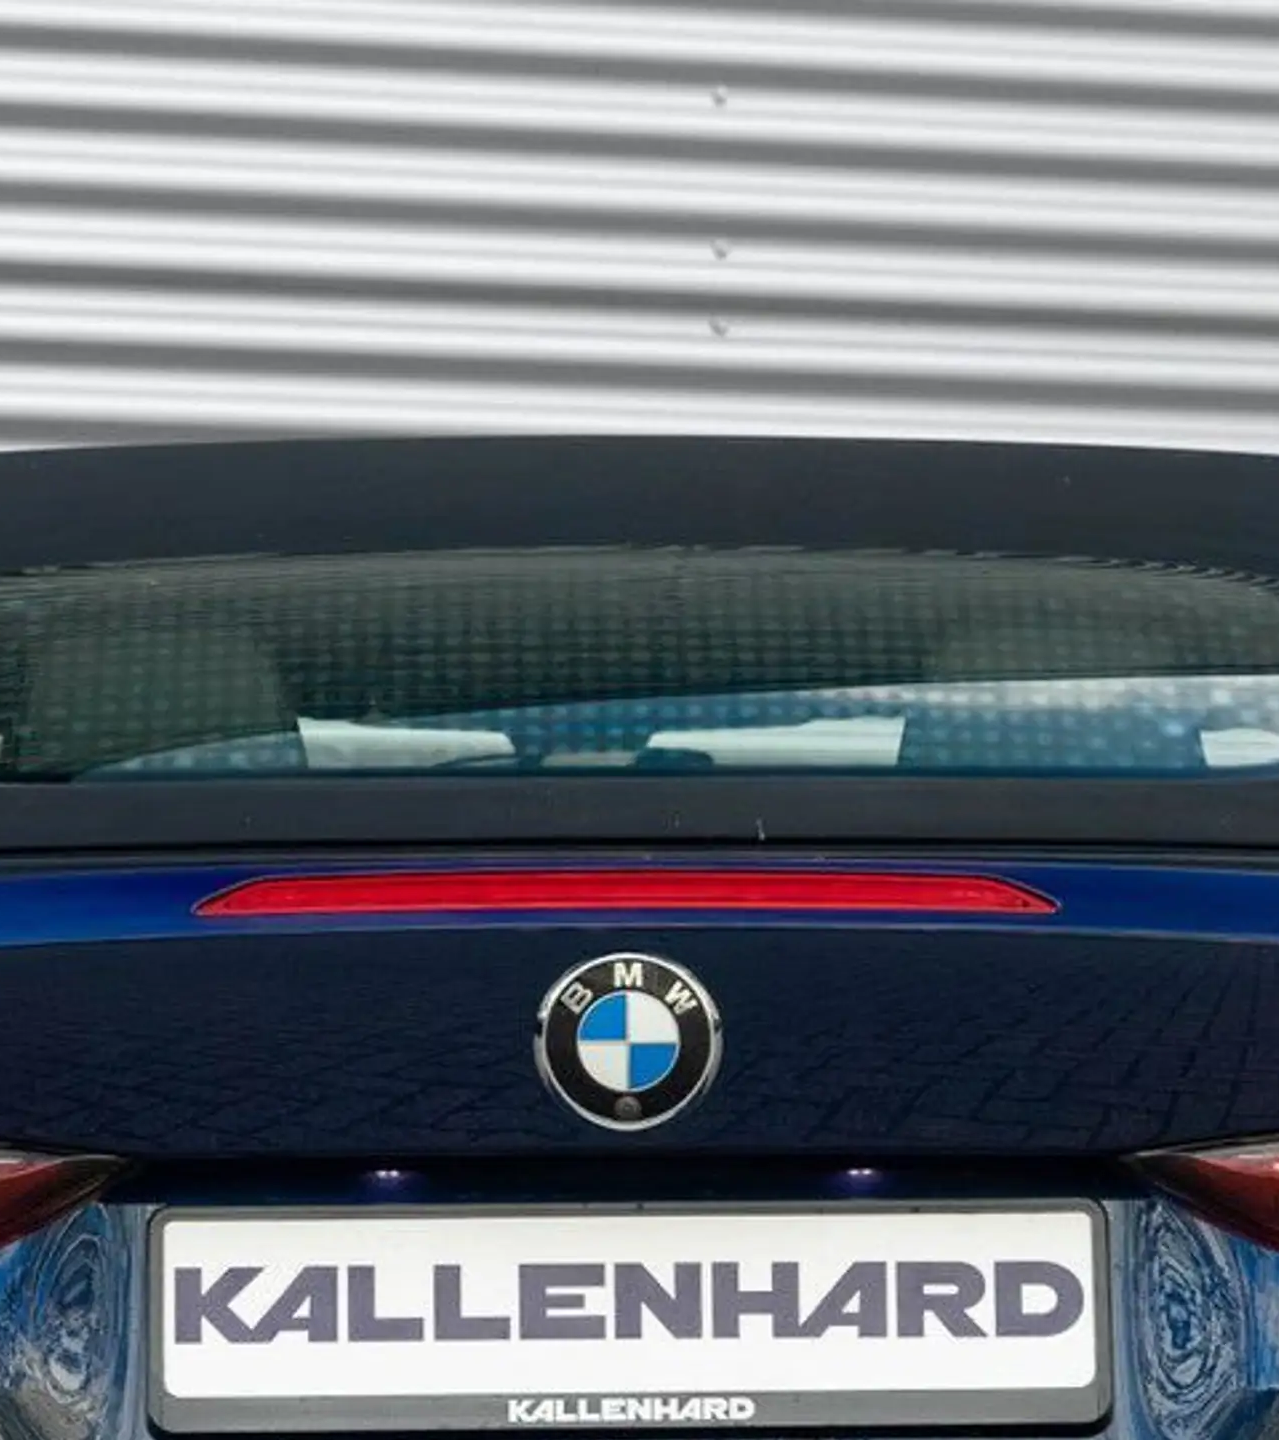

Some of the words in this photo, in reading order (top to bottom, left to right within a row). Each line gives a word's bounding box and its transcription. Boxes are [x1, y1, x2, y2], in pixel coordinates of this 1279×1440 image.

[561, 962, 698, 1015] BMW
[173, 1261, 1085, 1344] KALLENHARD
[507, 1397, 755, 1423] KALLENHARD
